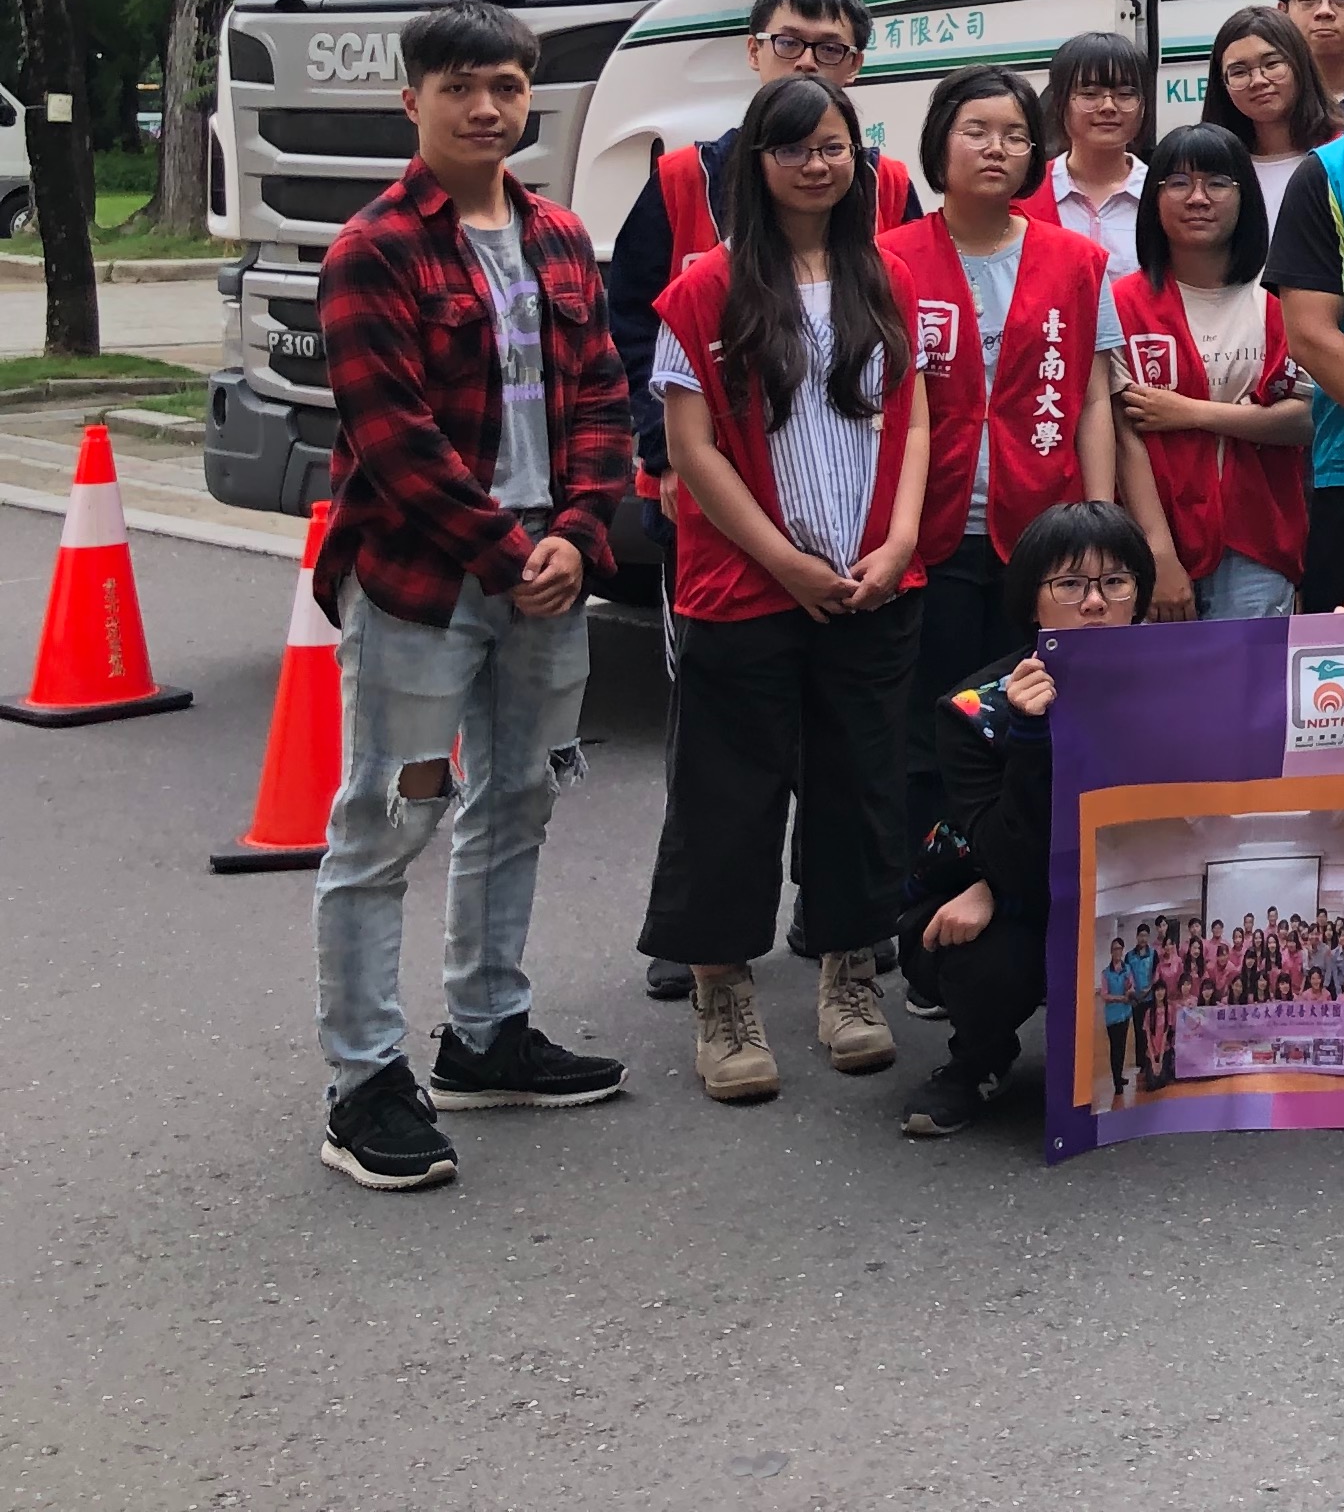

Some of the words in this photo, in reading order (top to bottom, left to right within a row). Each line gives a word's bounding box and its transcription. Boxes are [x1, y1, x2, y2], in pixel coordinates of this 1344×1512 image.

[268, 332, 279, 353] P
[282, 333, 315, 356] 310
[1031, 308, 1066, 457] 臺南大學
